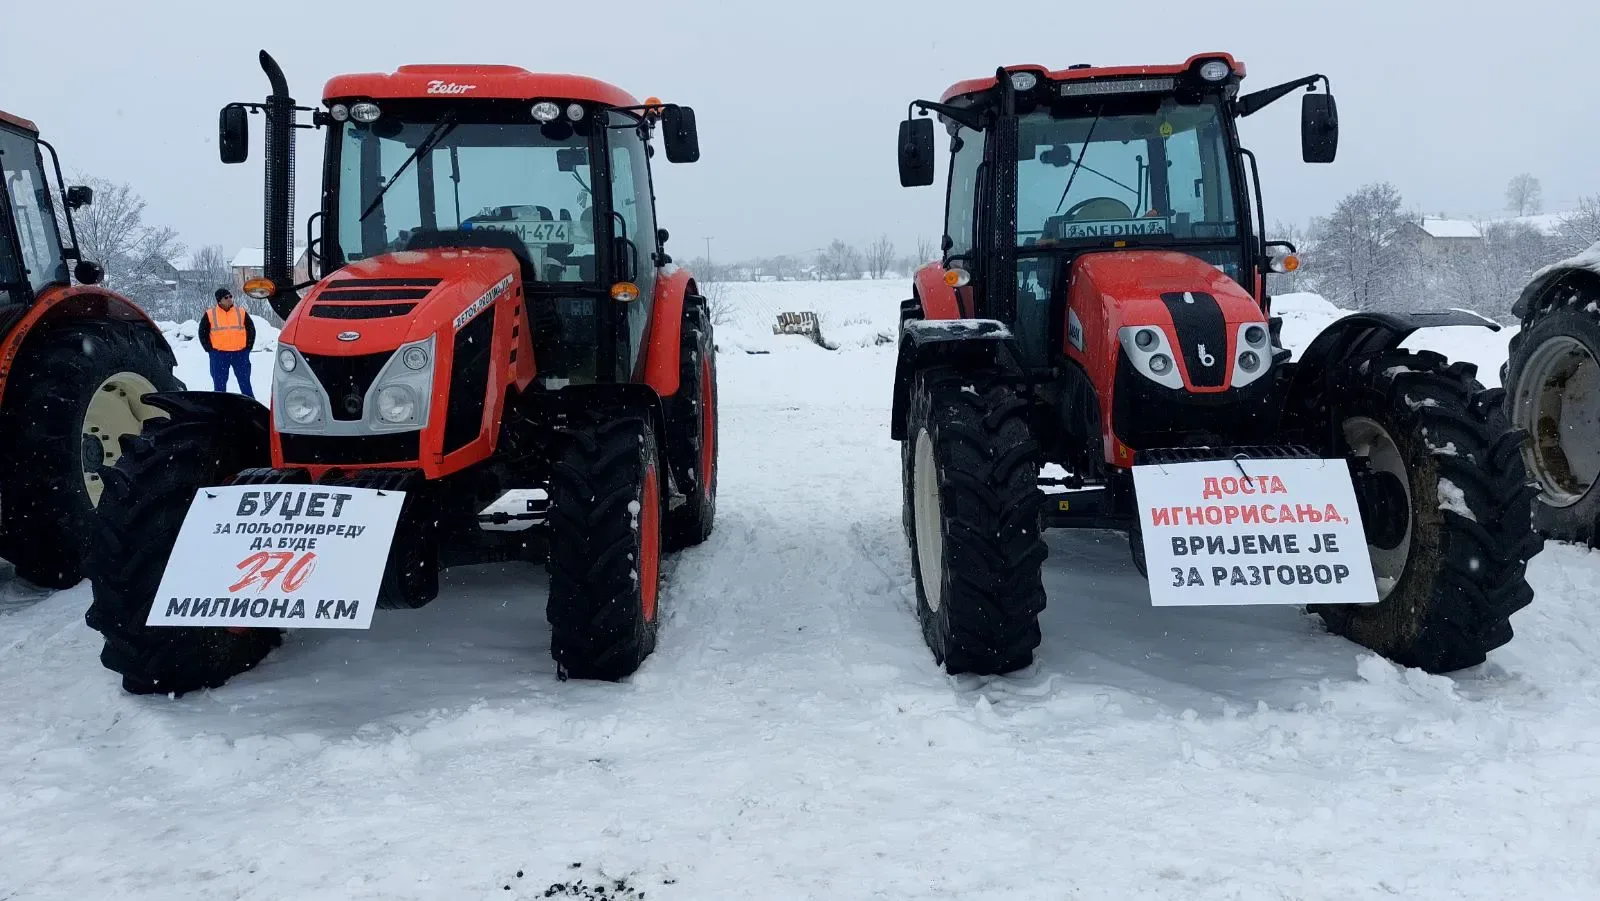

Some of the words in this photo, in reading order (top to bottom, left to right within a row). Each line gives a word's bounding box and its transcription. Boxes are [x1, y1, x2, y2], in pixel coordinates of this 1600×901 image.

[427, 80, 476, 94] Zetor
[1086, 223, 1146, 236] NEDIM
[1203, 476, 1287, 499] ДОСТА
[236, 492, 352, 520] БУЏЕТ
[1152, 504, 1349, 526] ИГНОРИСАЊА,
[213, 523, 230, 534] ЗА
[235, 523, 366, 538] ПОЉОПРИВРЕДУ
[249, 537, 272, 550] ДА
[277, 537, 317, 551] БУДЕ
[1172, 534, 1300, 555] ВРИЈЕМЕ
[1308, 533, 1339, 553] ЈЕ
[228, 552, 317, 594] 270
[1171, 567, 1204, 587] ЗА
[1212, 565, 1349, 586] РАЗГОВОР
[165, 598, 305, 618] МИЛИОНА
[315, 600, 359, 619] КМ
